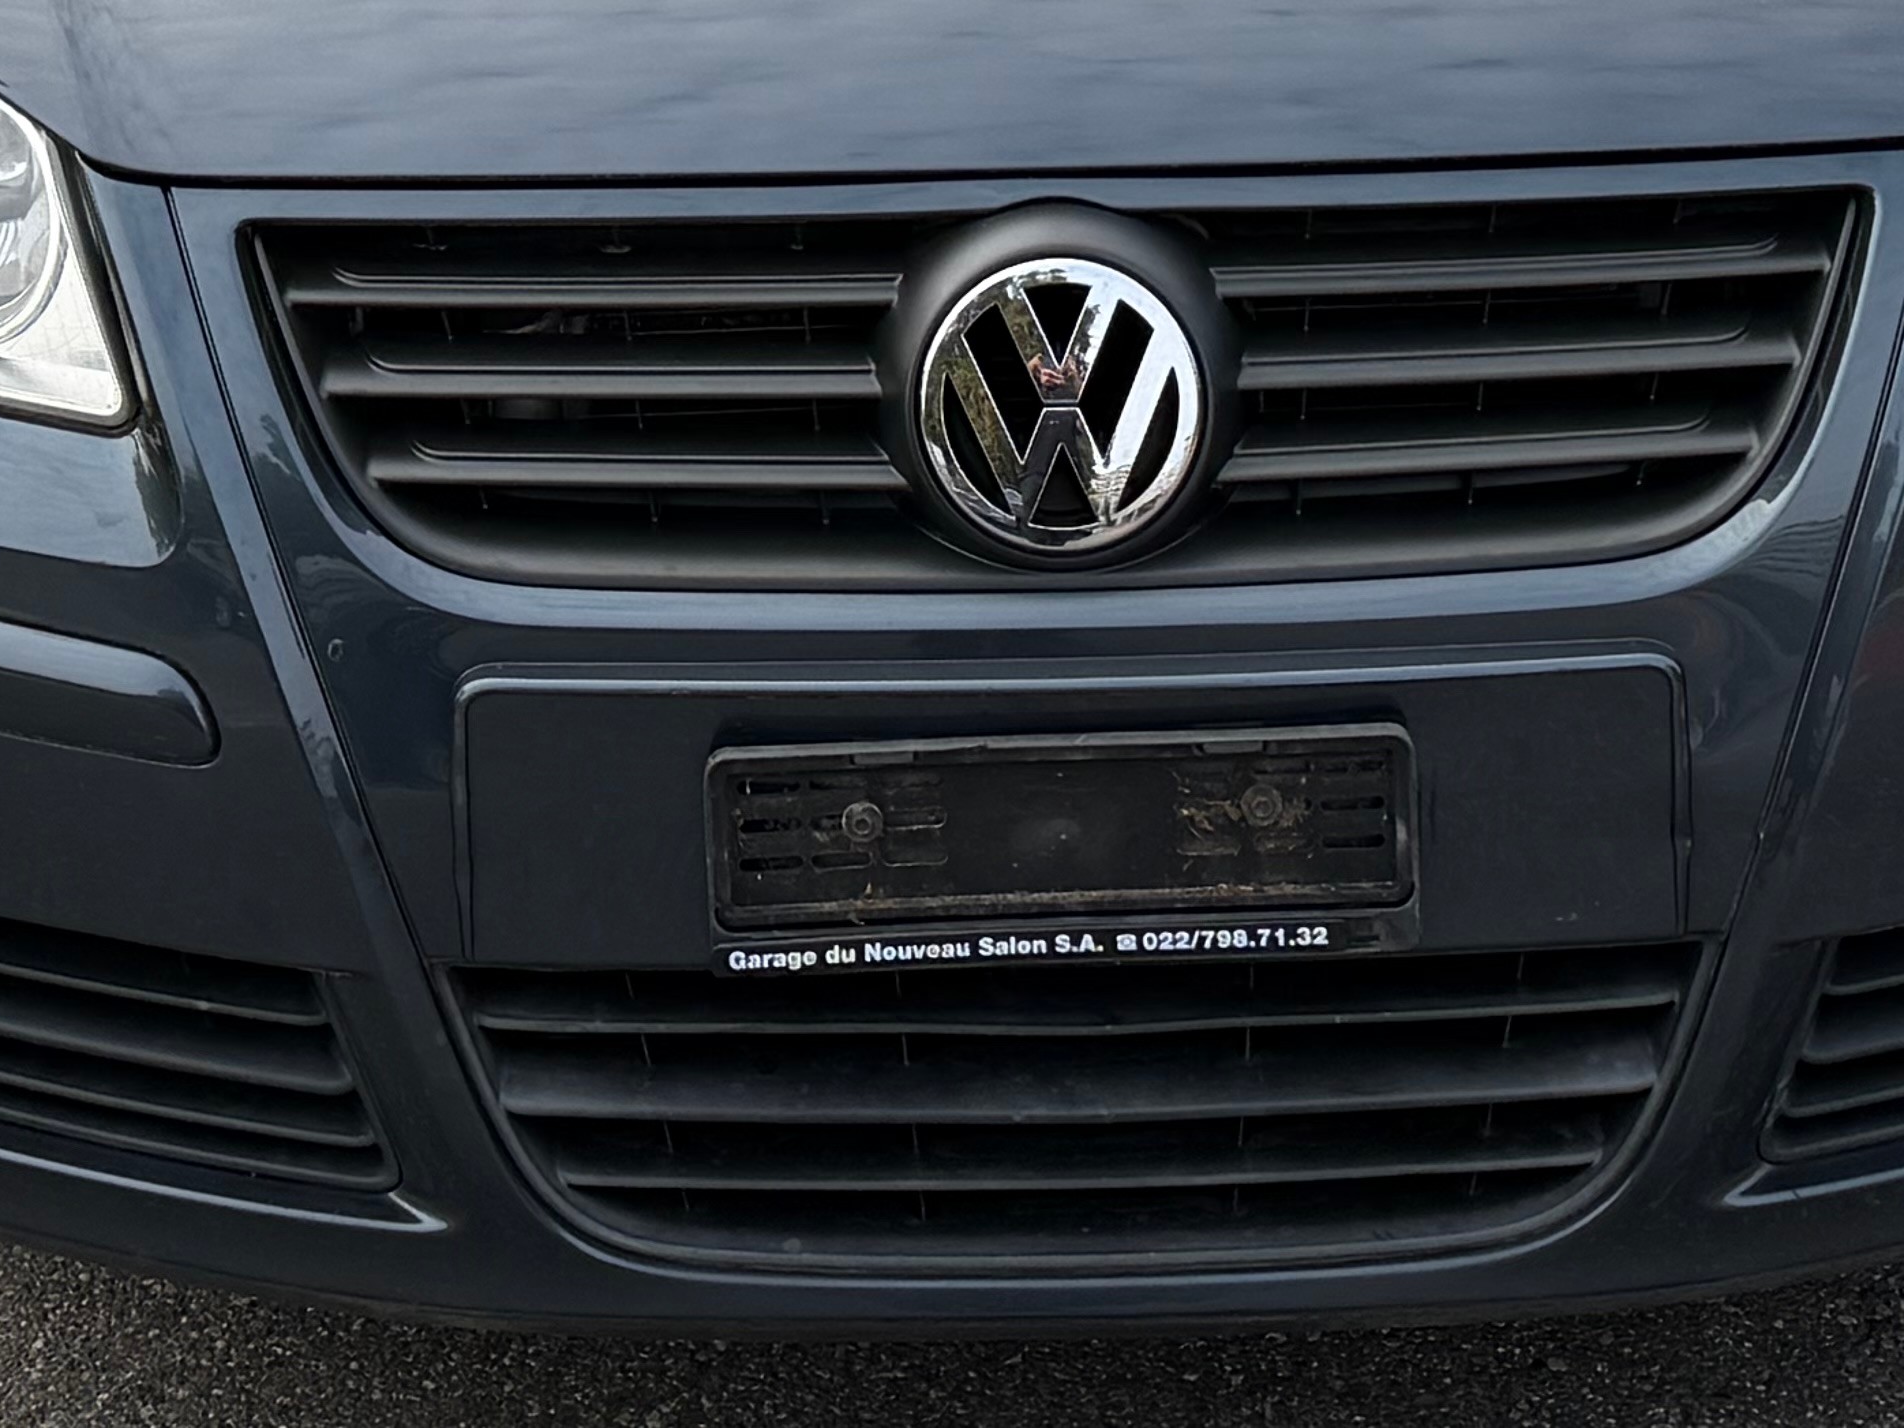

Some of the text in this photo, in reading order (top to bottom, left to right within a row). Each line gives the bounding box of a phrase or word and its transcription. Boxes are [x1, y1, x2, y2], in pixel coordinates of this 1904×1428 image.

[728, 926, 1330, 971] Garage du Nouveau Salon S.A. 022/798.71.32
